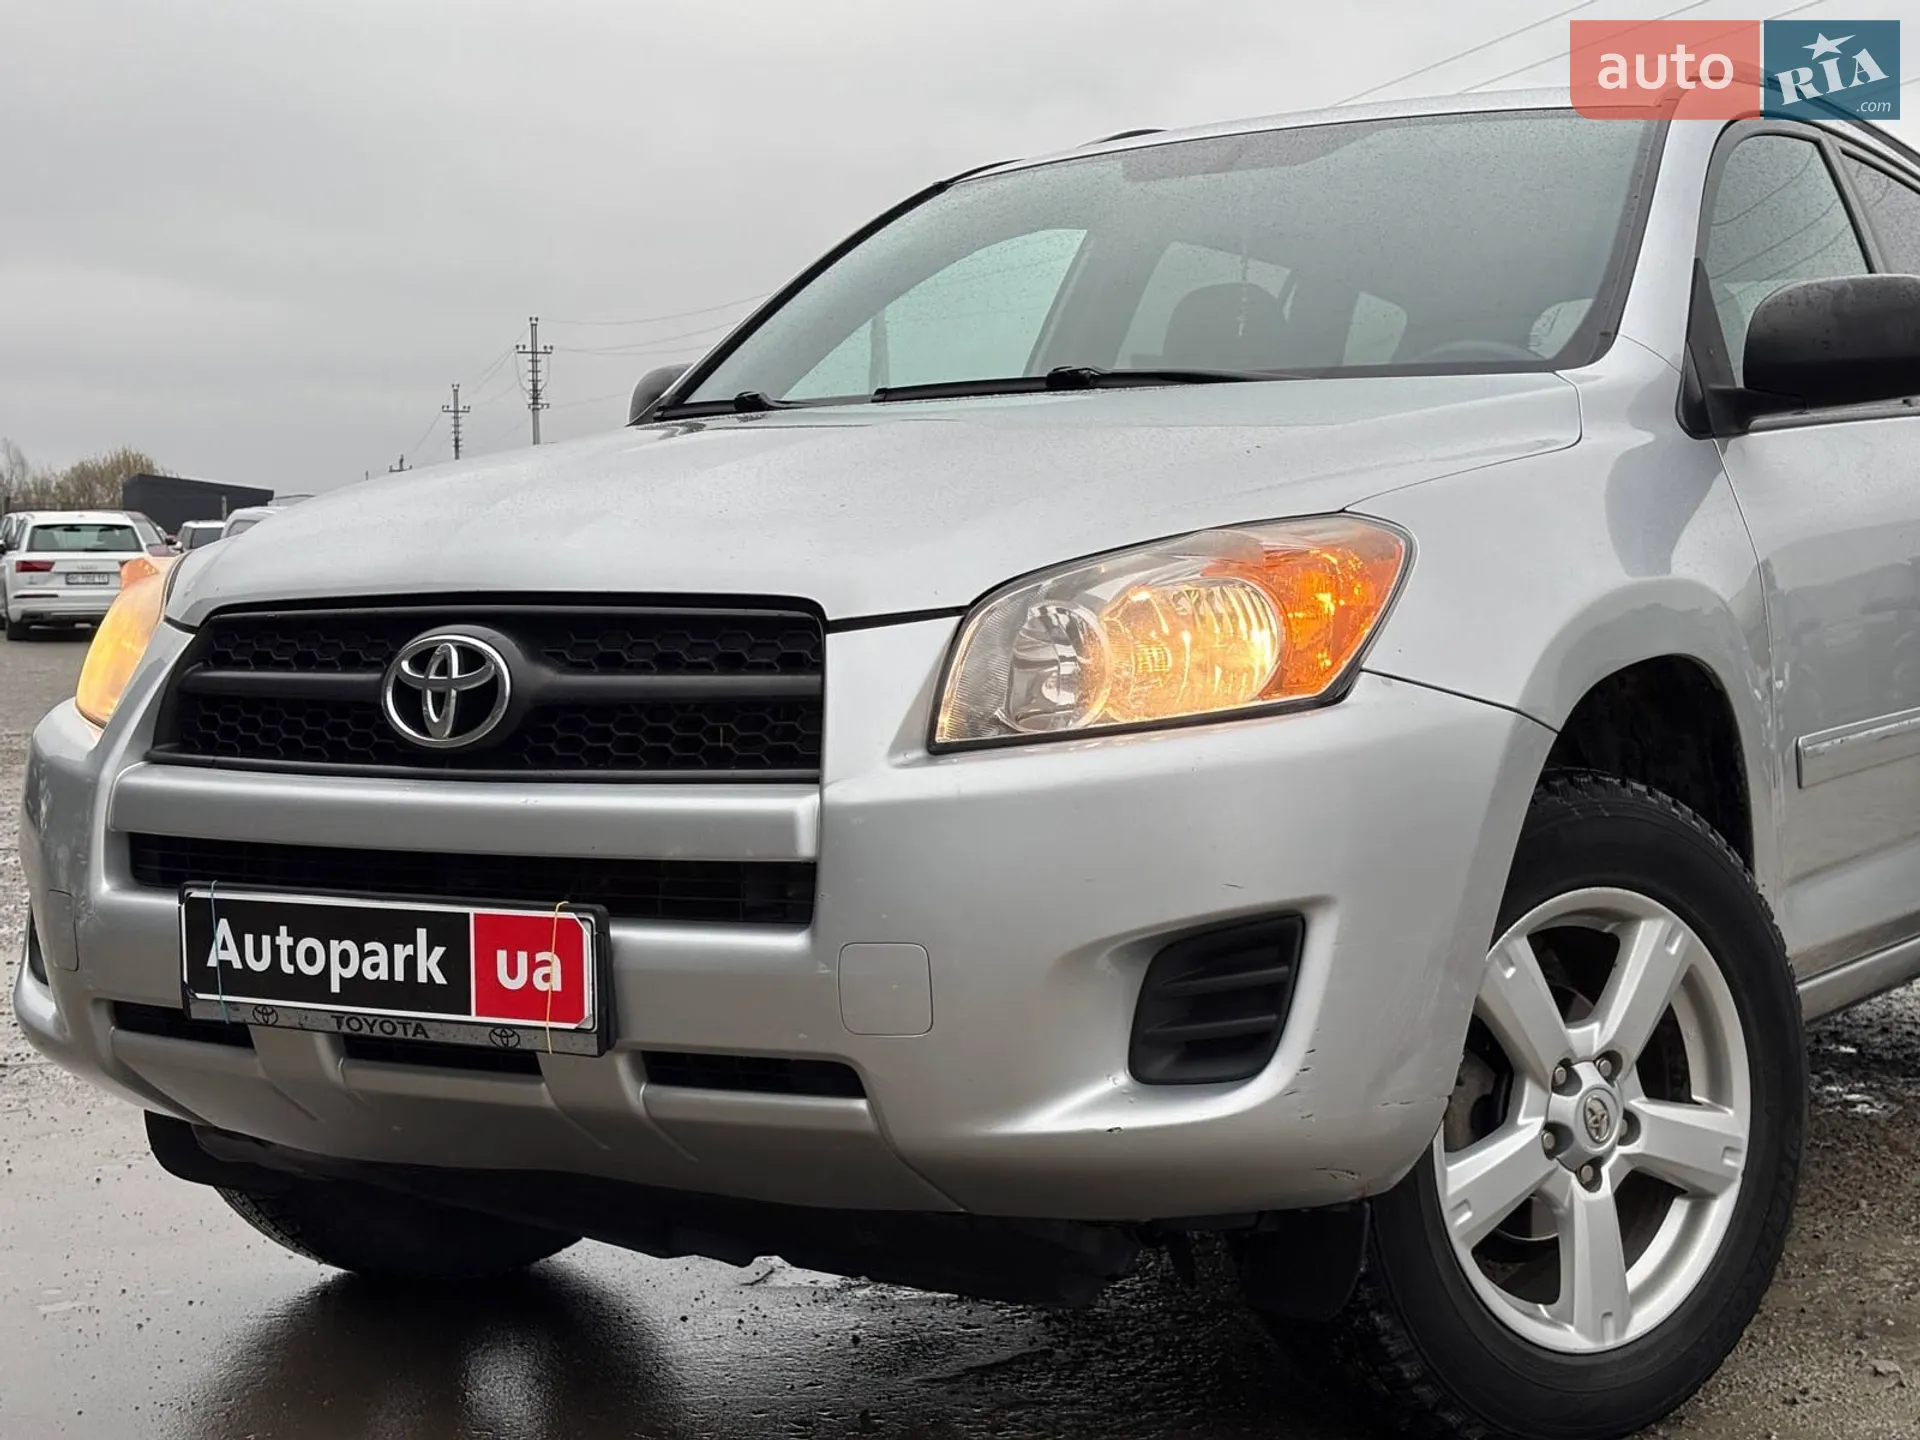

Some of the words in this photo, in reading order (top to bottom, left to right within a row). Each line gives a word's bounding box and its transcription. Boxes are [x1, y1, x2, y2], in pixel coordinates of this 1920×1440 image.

[207, 918, 448, 992] Autopark
[497, 949, 562, 992] ua
[331, 1015, 429, 1039] TOYOTA
